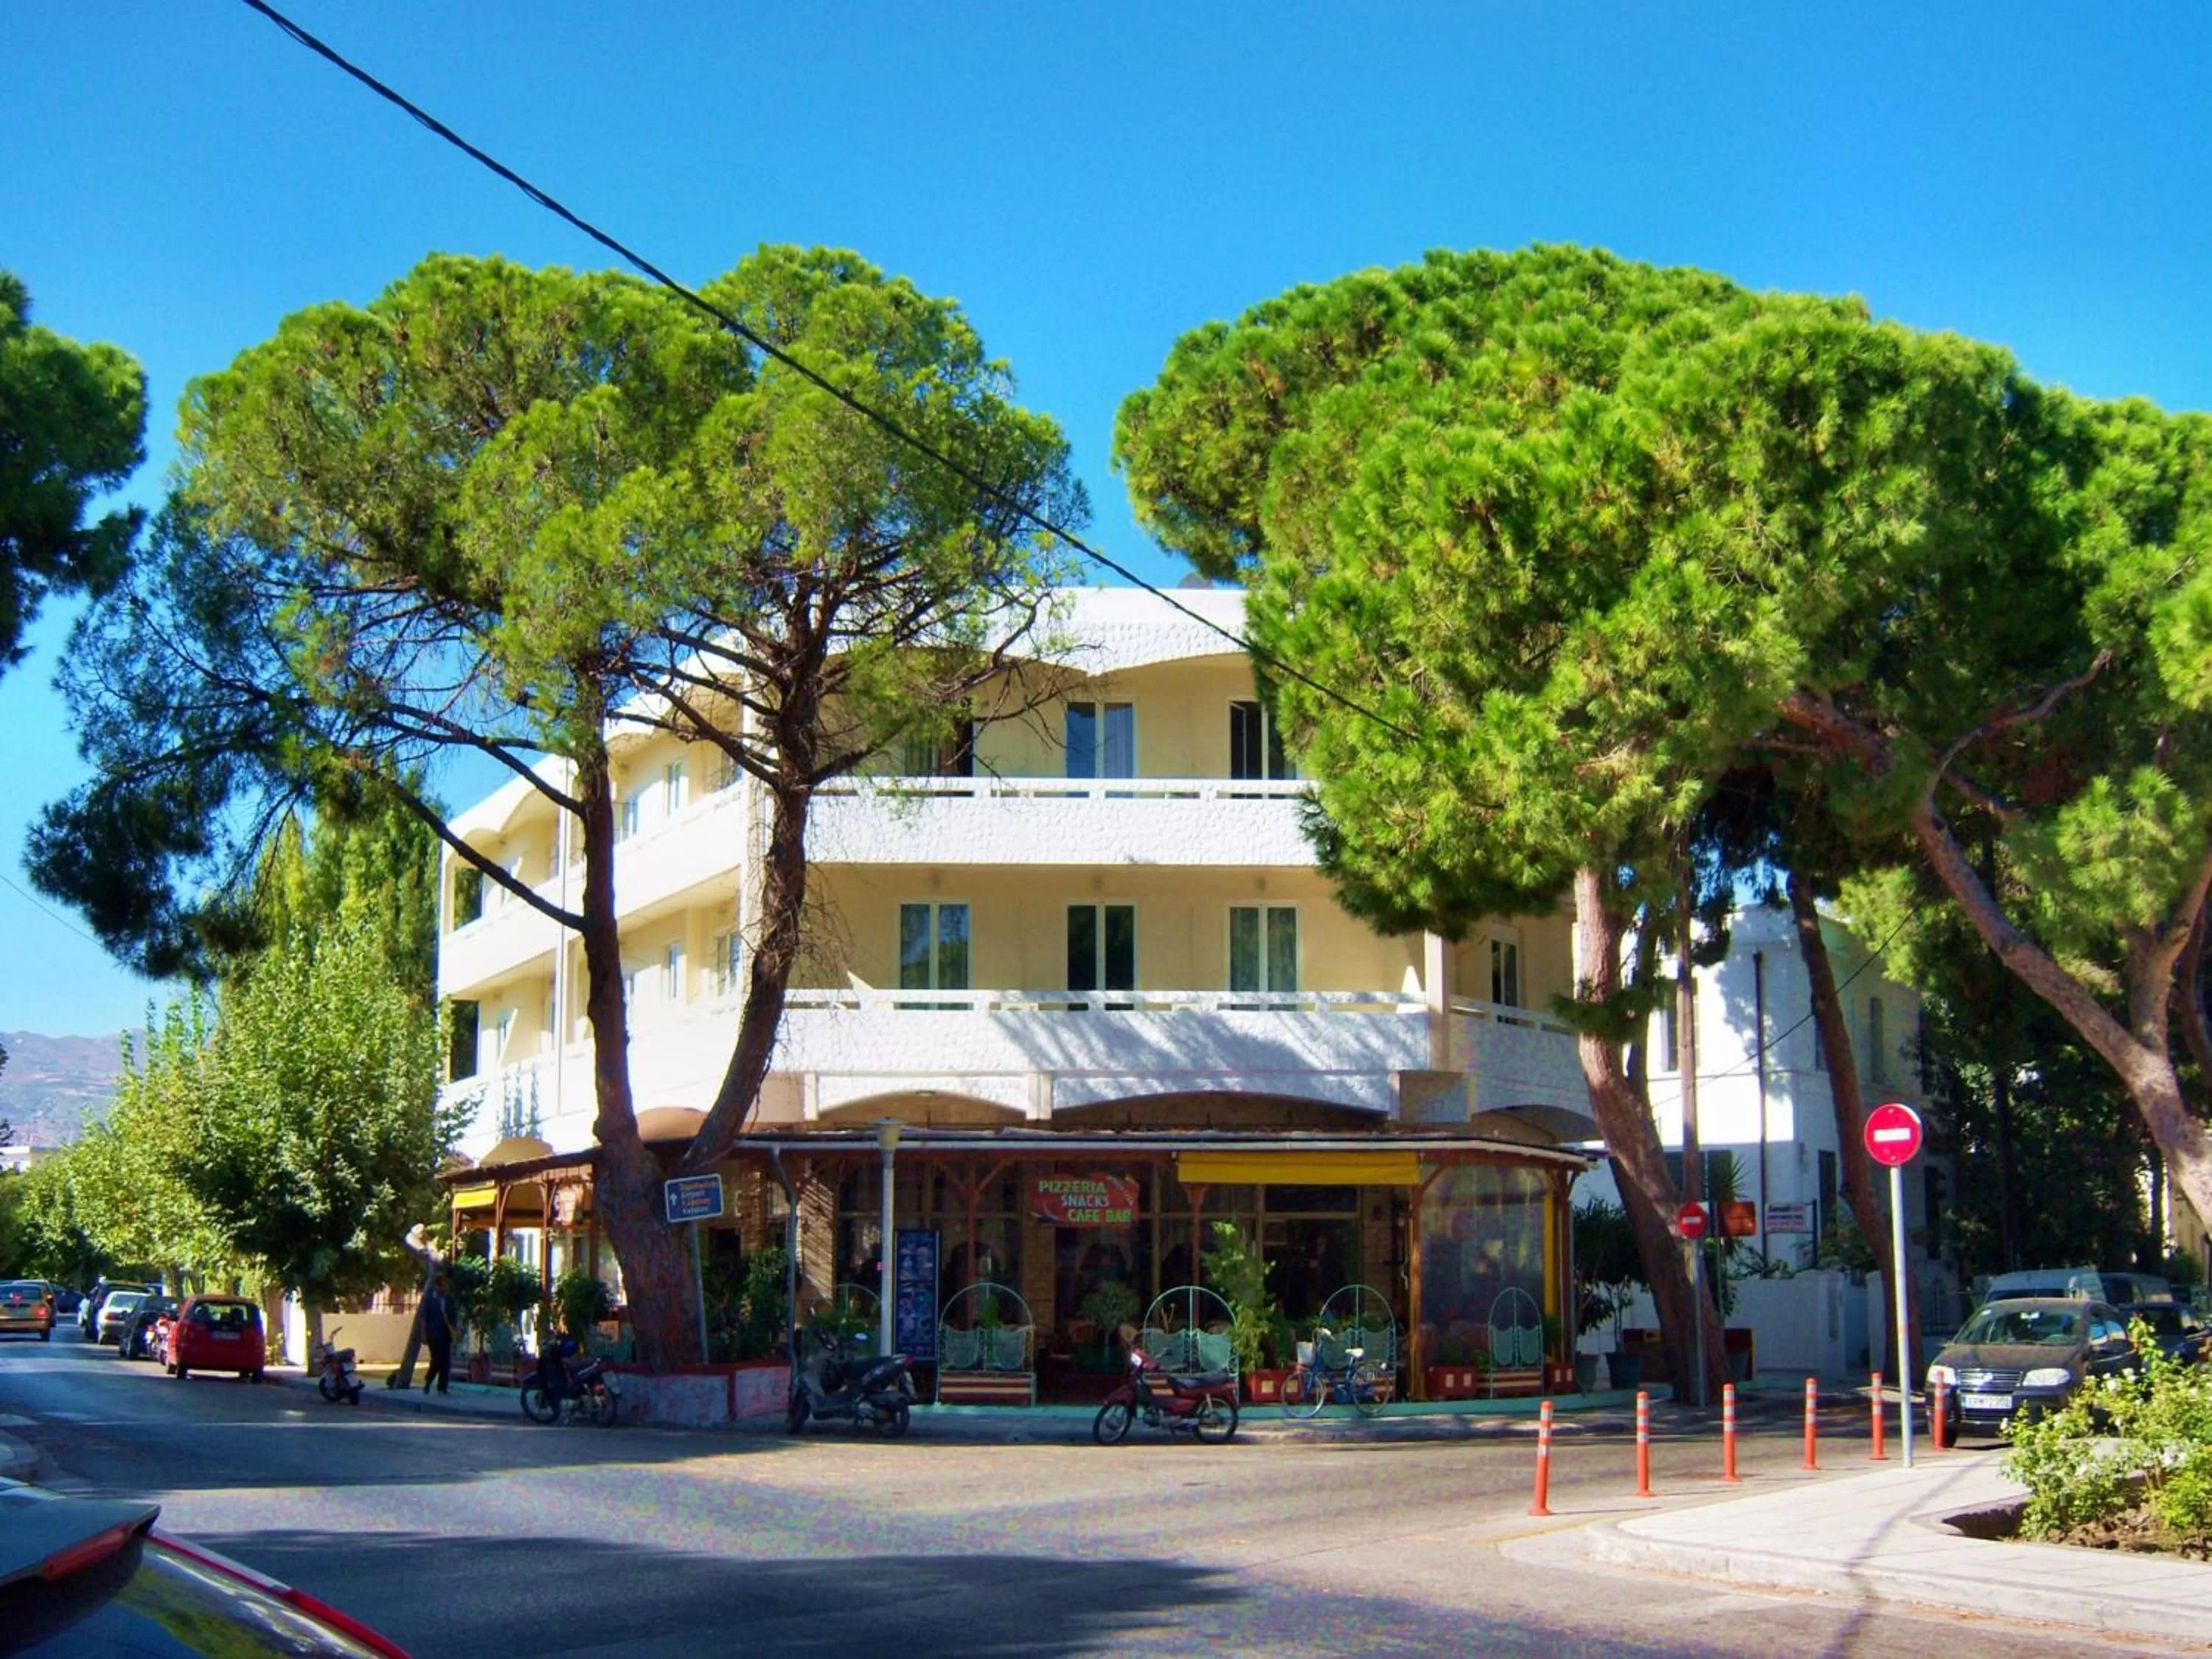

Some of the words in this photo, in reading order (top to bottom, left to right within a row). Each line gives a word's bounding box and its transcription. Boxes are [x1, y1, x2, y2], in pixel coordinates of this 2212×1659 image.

[1038, 1180, 1107, 1193] PIZZERIA
[1061, 1194, 1110, 1207] SNACKS
[1068, 1208, 1100, 1222] CAFE
[1105, 1208, 1133, 1222] BAR
